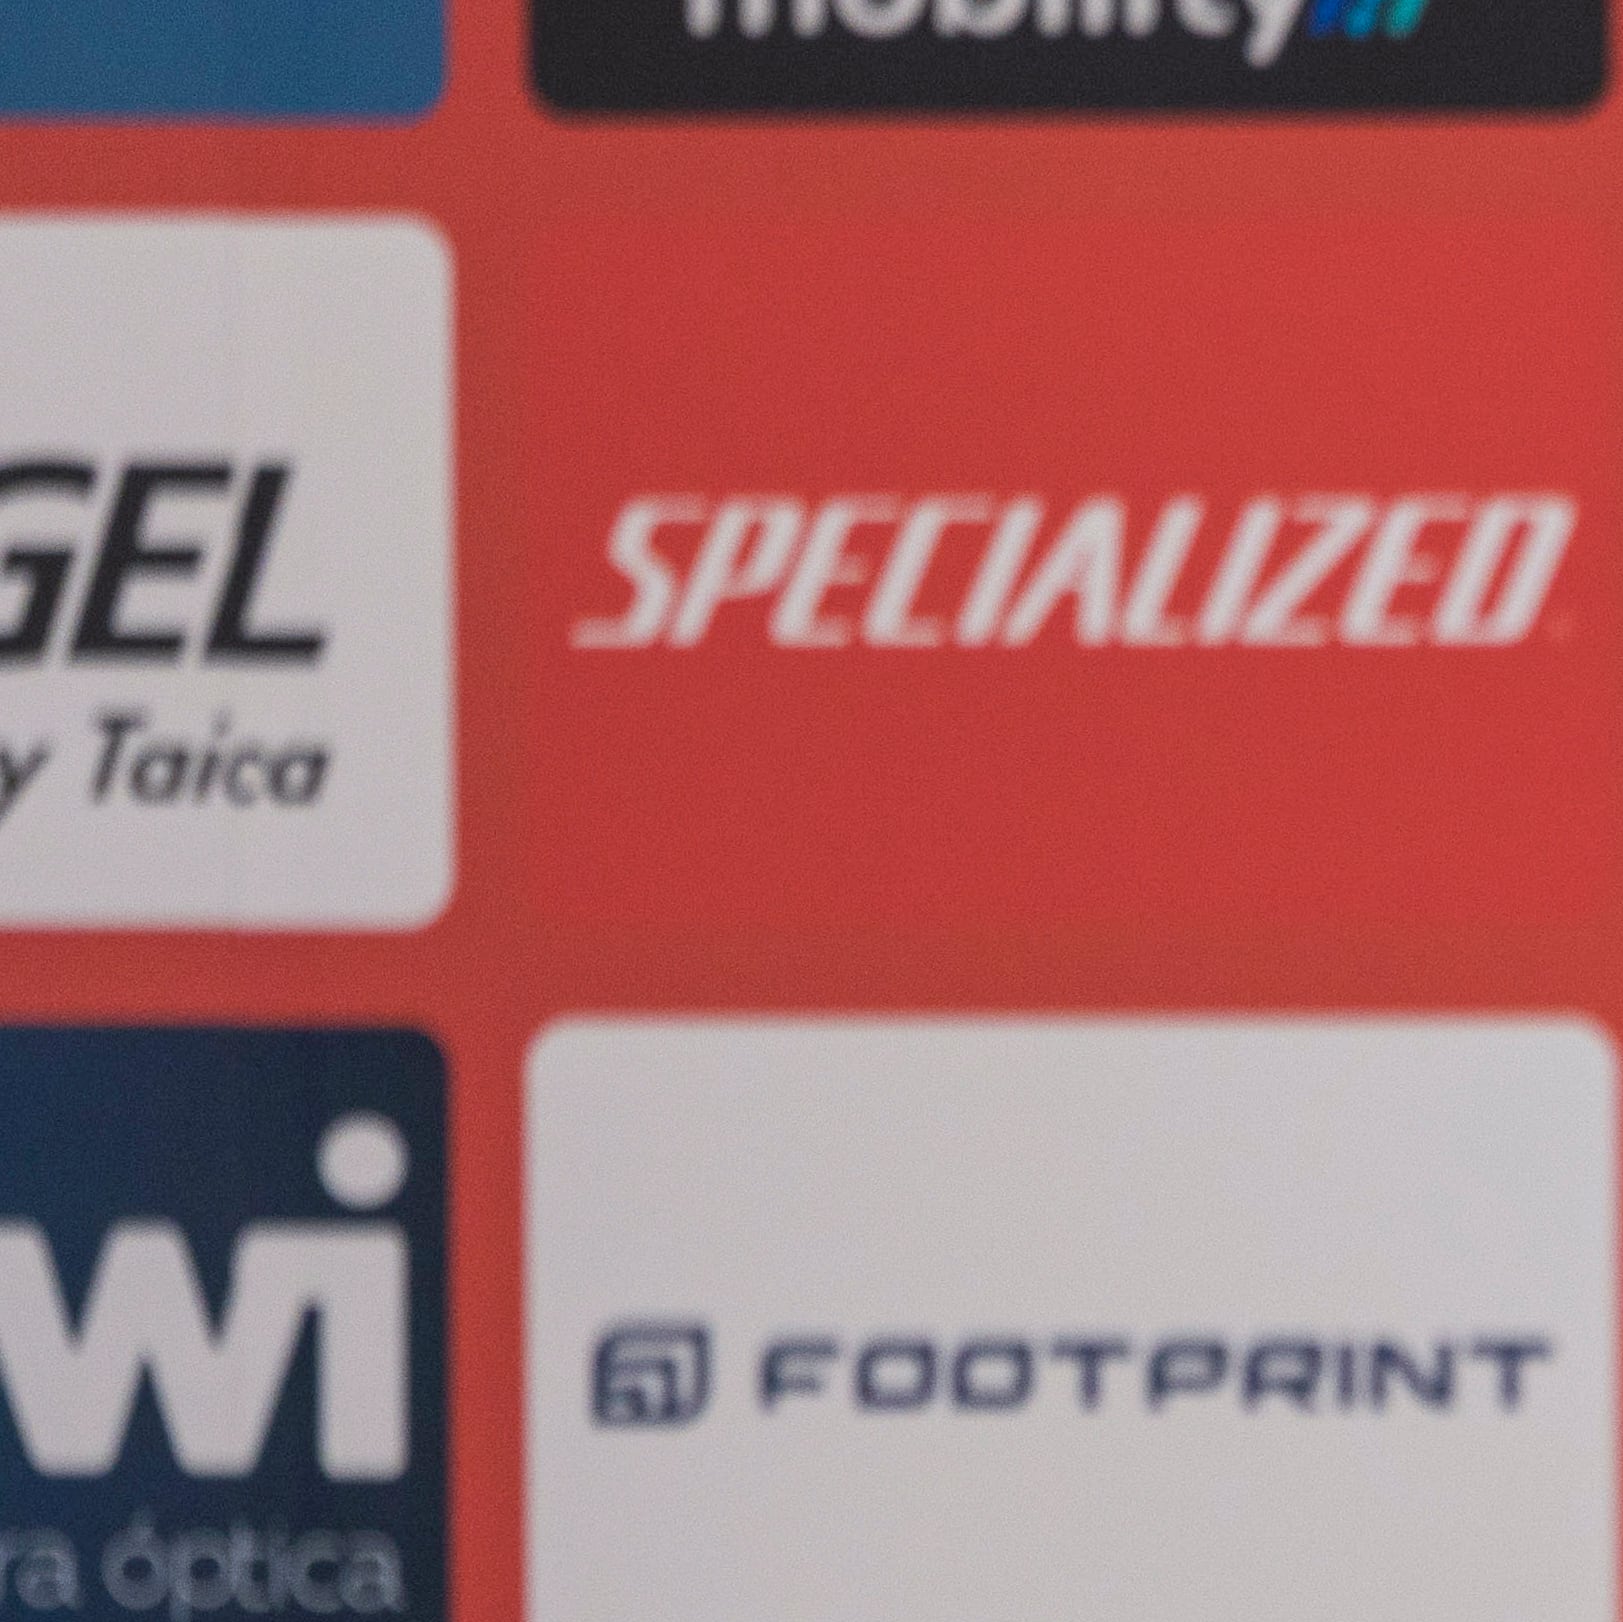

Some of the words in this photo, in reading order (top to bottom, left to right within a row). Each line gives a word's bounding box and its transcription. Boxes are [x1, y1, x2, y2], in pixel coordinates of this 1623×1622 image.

[570, 494, 1578, 650] SPECIALIZED
[92, 706, 332, 808] Taica
[757, 1332, 1556, 1414] FOOTPRINT
